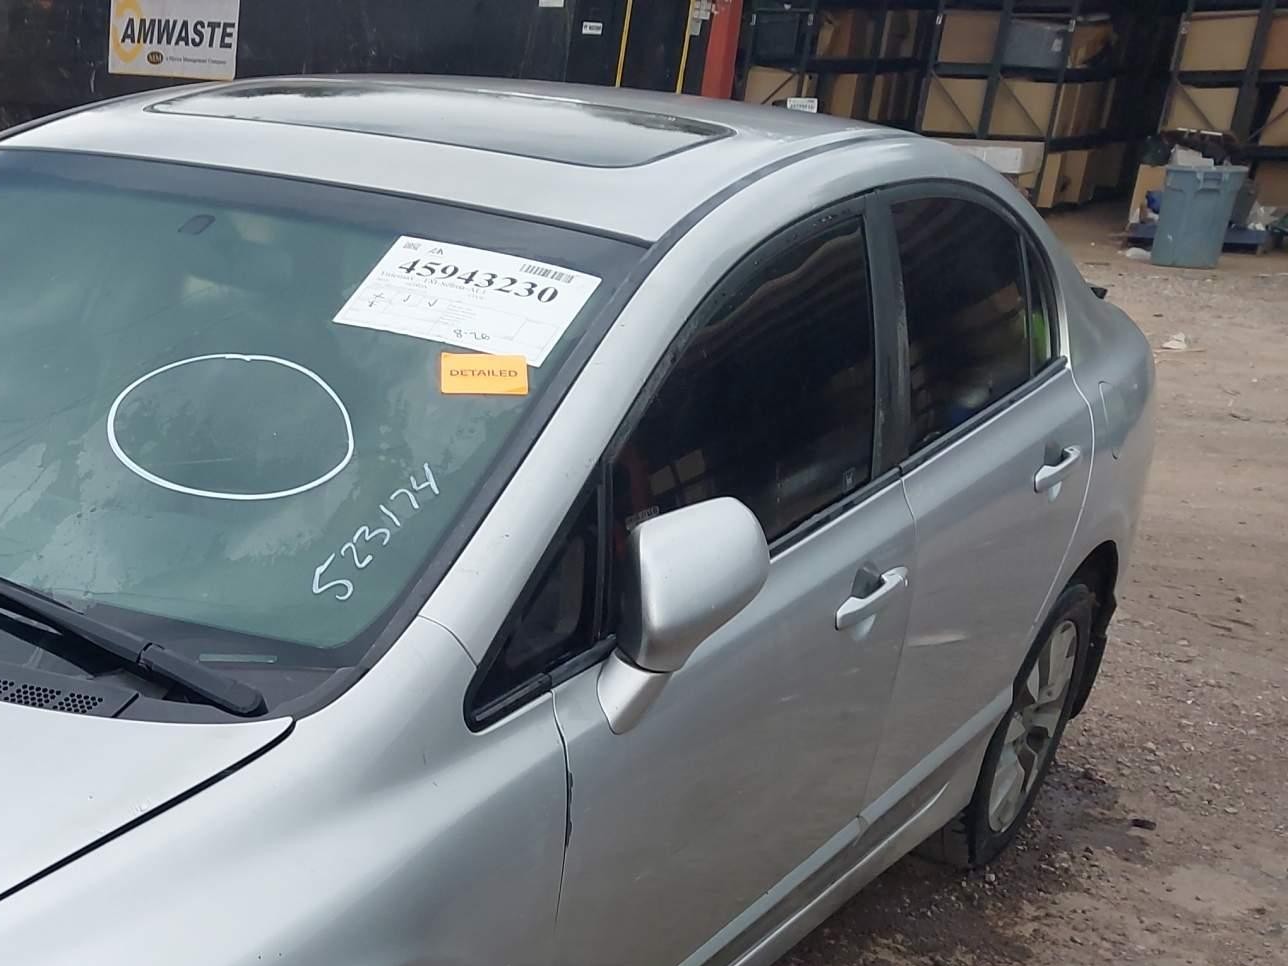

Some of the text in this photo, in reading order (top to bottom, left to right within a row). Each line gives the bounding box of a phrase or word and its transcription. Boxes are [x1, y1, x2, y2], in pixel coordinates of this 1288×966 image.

[121, 18, 235, 48] AMWASTE
[398, 259, 558, 303] 45943230
[449, 368, 518, 377] DETAILED
[312, 462, 440, 600] 523174
